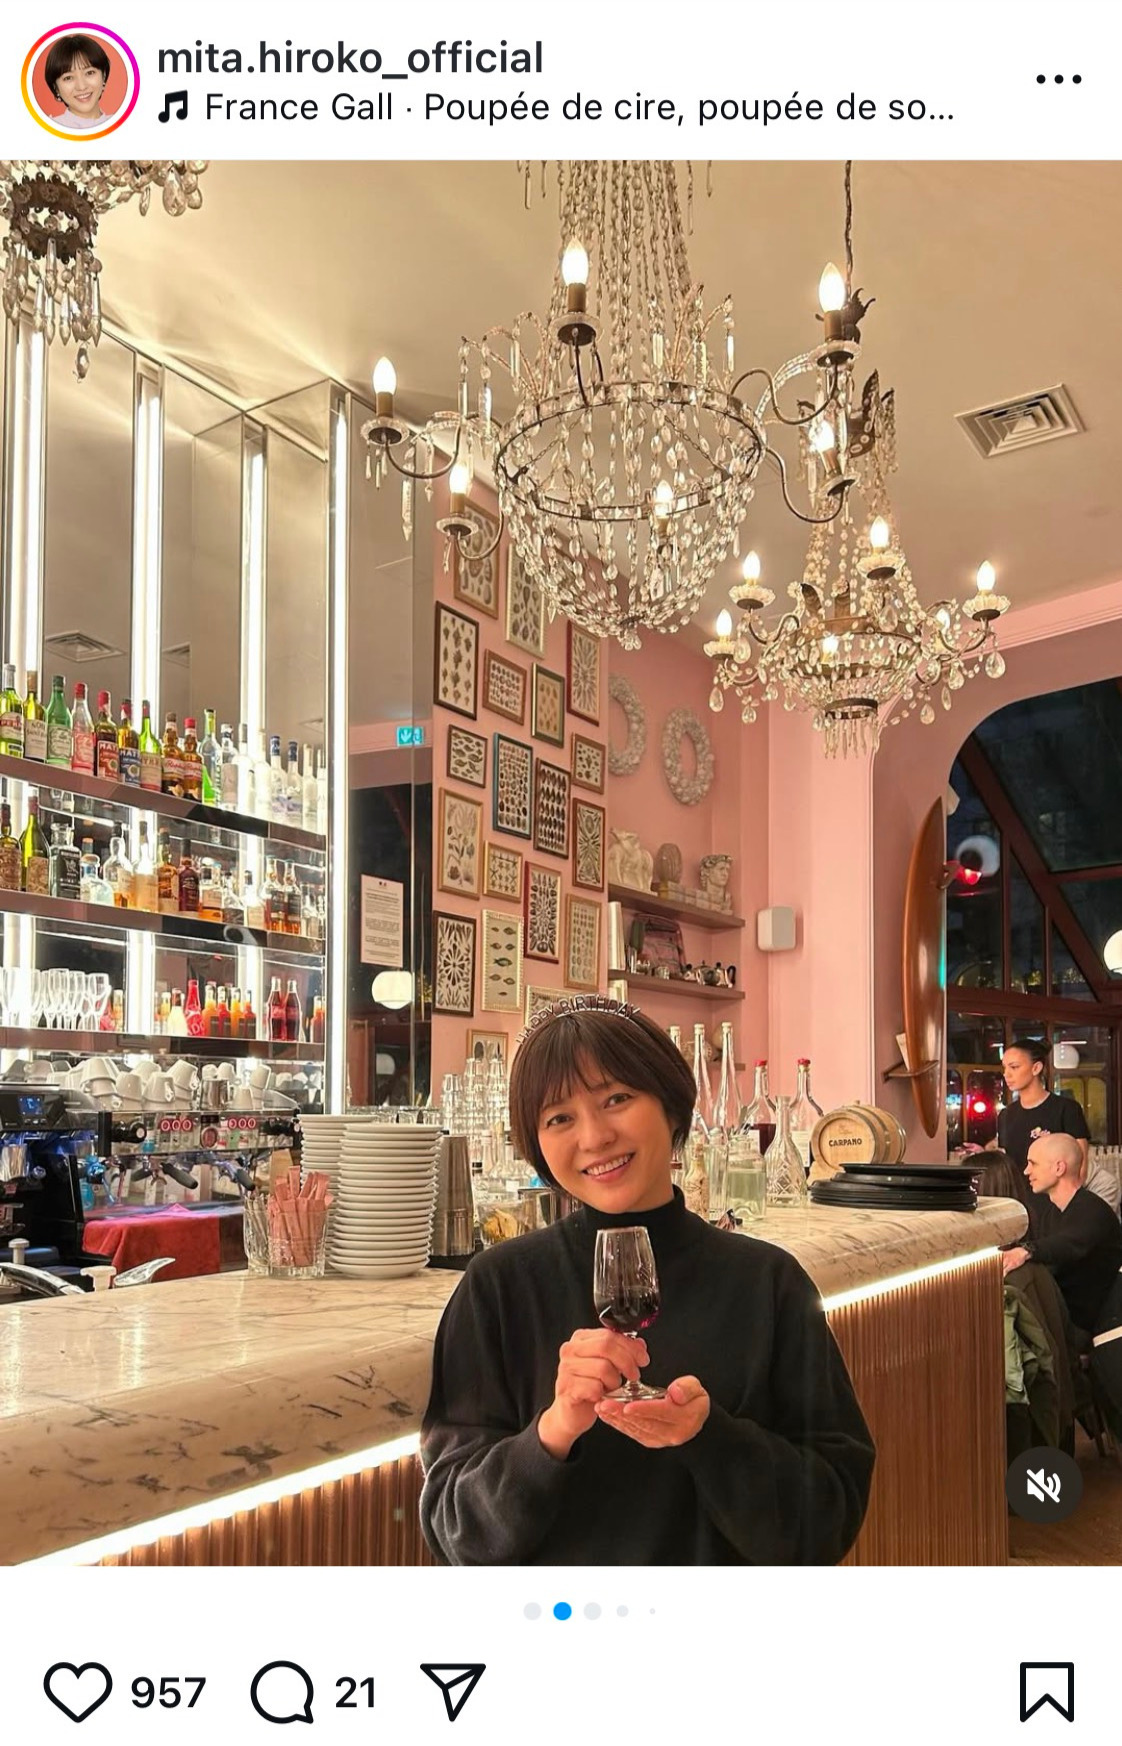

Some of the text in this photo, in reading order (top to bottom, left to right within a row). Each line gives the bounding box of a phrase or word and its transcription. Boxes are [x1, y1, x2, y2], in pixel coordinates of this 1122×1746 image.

[515, 994, 641, 1045] HAPPY BIRTHDAY
[828, 1137, 863, 1147] CARPANO
